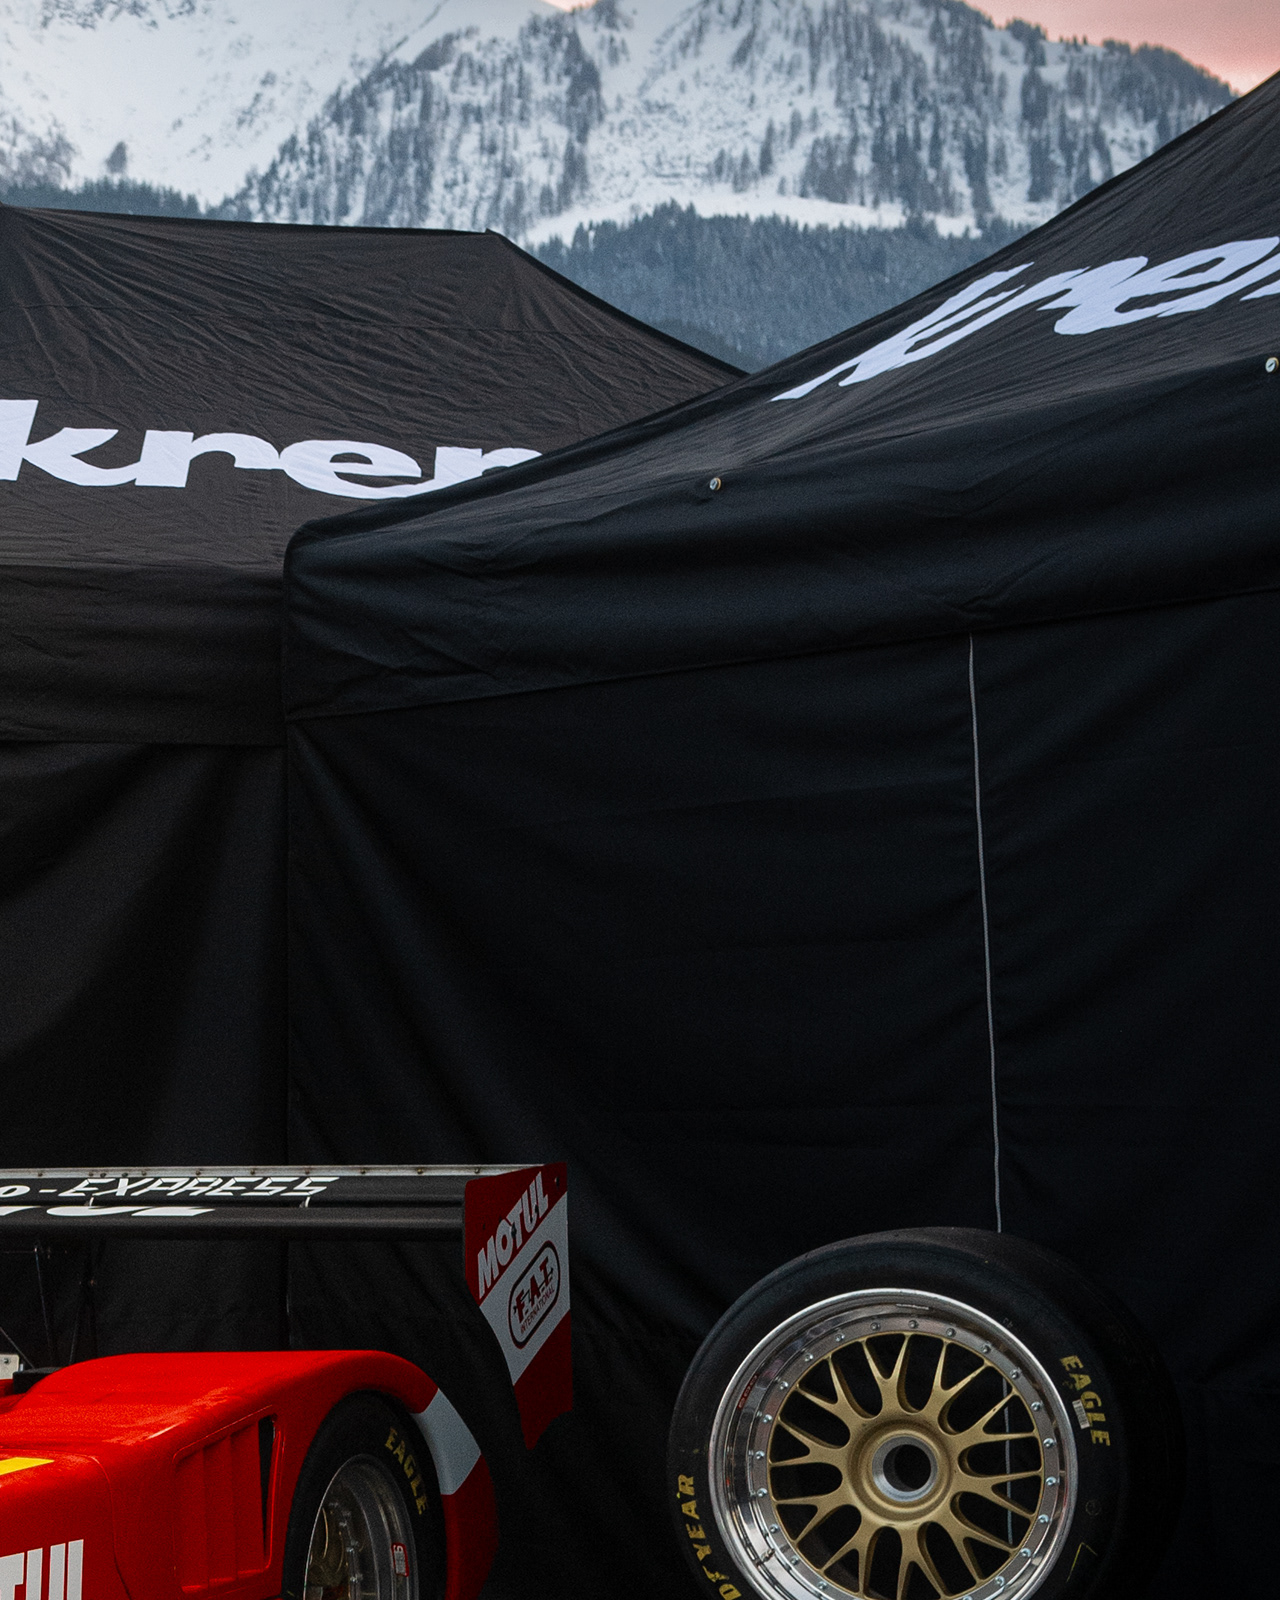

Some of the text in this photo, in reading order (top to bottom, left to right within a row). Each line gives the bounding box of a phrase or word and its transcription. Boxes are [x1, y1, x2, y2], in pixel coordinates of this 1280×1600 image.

[768, 236, 1280, 401] kre
[477, 1171, 548, 1300] MOTUL
[1059, 1354, 1111, 1446] EAGLE
[385, 1427, 427, 1515] EAGLE
